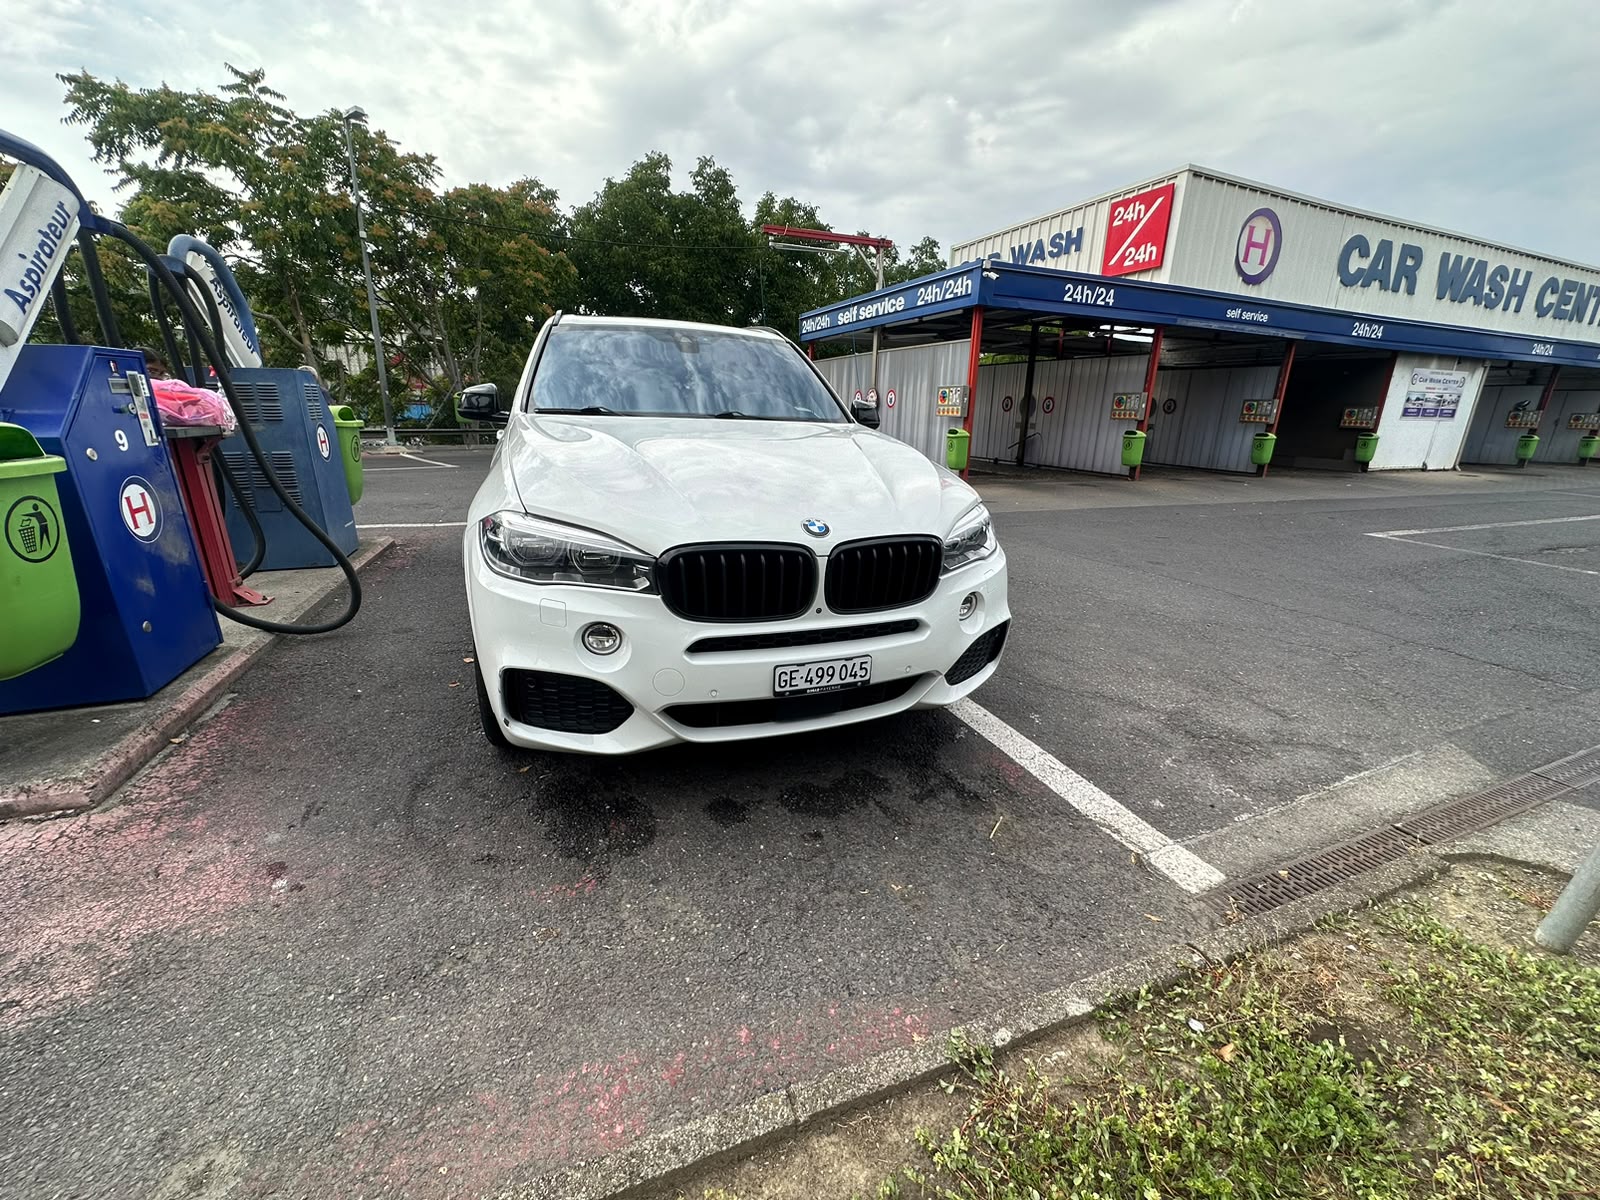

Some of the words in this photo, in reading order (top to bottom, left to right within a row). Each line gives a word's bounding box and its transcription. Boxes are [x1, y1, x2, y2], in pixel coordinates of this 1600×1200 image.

[1112, 202, 1145, 227] 24h
[4, 200, 71, 315] Aspirateur
[1010, 226, 1083, 265] WASH
[1123, 242, 1157, 267] 24h
[1241, 225, 1272, 266] H
[1338, 233, 1424, 295] CAR
[1436, 251, 1533, 313] WASH
[1535, 276, 1600, 327] CENT
[210, 277, 256, 354] Aspirateur
[802, 314, 831, 334] 24h/24h
[837, 305, 858, 325] self
[859, 296, 905, 319] service
[917, 276, 972, 306] 24h/24h
[1064, 284, 1115, 306] 24h/24
[1226, 308, 1241, 319] self
[1241, 311, 1268, 323] service
[1352, 322, 1384, 339] 24h/24
[114, 429, 128, 452] 9
[124, 492, 154, 530] H
[839, 661, 869, 681] 045
